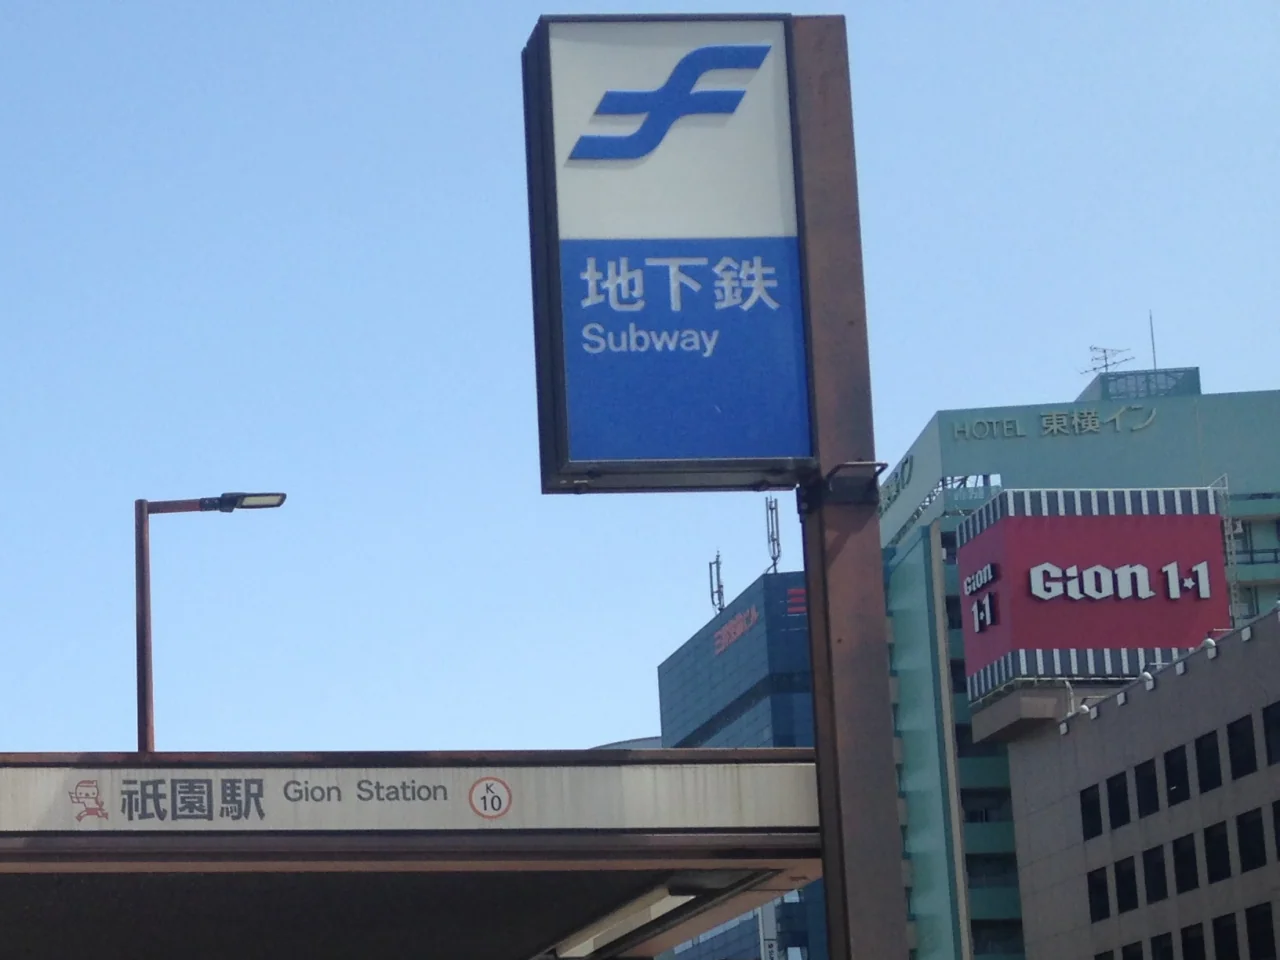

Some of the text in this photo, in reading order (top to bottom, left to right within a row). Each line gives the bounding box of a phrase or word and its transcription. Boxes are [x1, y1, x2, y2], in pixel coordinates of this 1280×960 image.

[580, 256, 781, 312] 地下鉄
[582, 323, 720, 358] Subway
[953, 404, 1157, 441] HOTEL 東横イン
[963, 563, 994, 596] Gion
[1029, 561, 1156, 600] Gion
[120, 778, 448, 821] 祇園駅 Gion Station
[480, 795, 502, 811] 10
[485, 783, 495, 794] K
